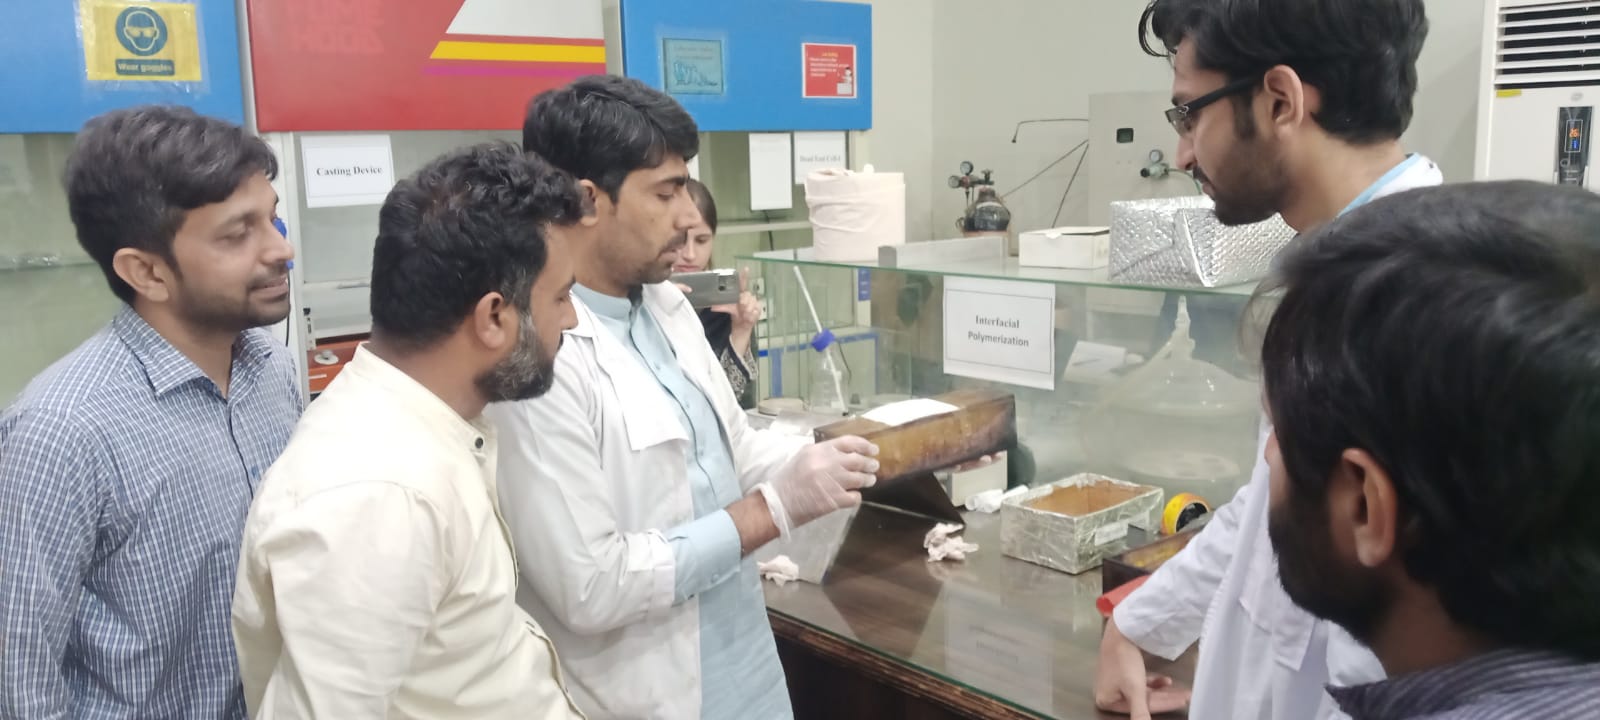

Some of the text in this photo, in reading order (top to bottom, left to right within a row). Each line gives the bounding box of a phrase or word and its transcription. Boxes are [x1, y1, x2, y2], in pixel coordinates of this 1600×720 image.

[117, 63, 172, 73] Wear goggles
[316, 166, 382, 177] Casting Device
[975, 314, 1020, 328] Interfacial
[967, 330, 1029, 347] Polymerization
